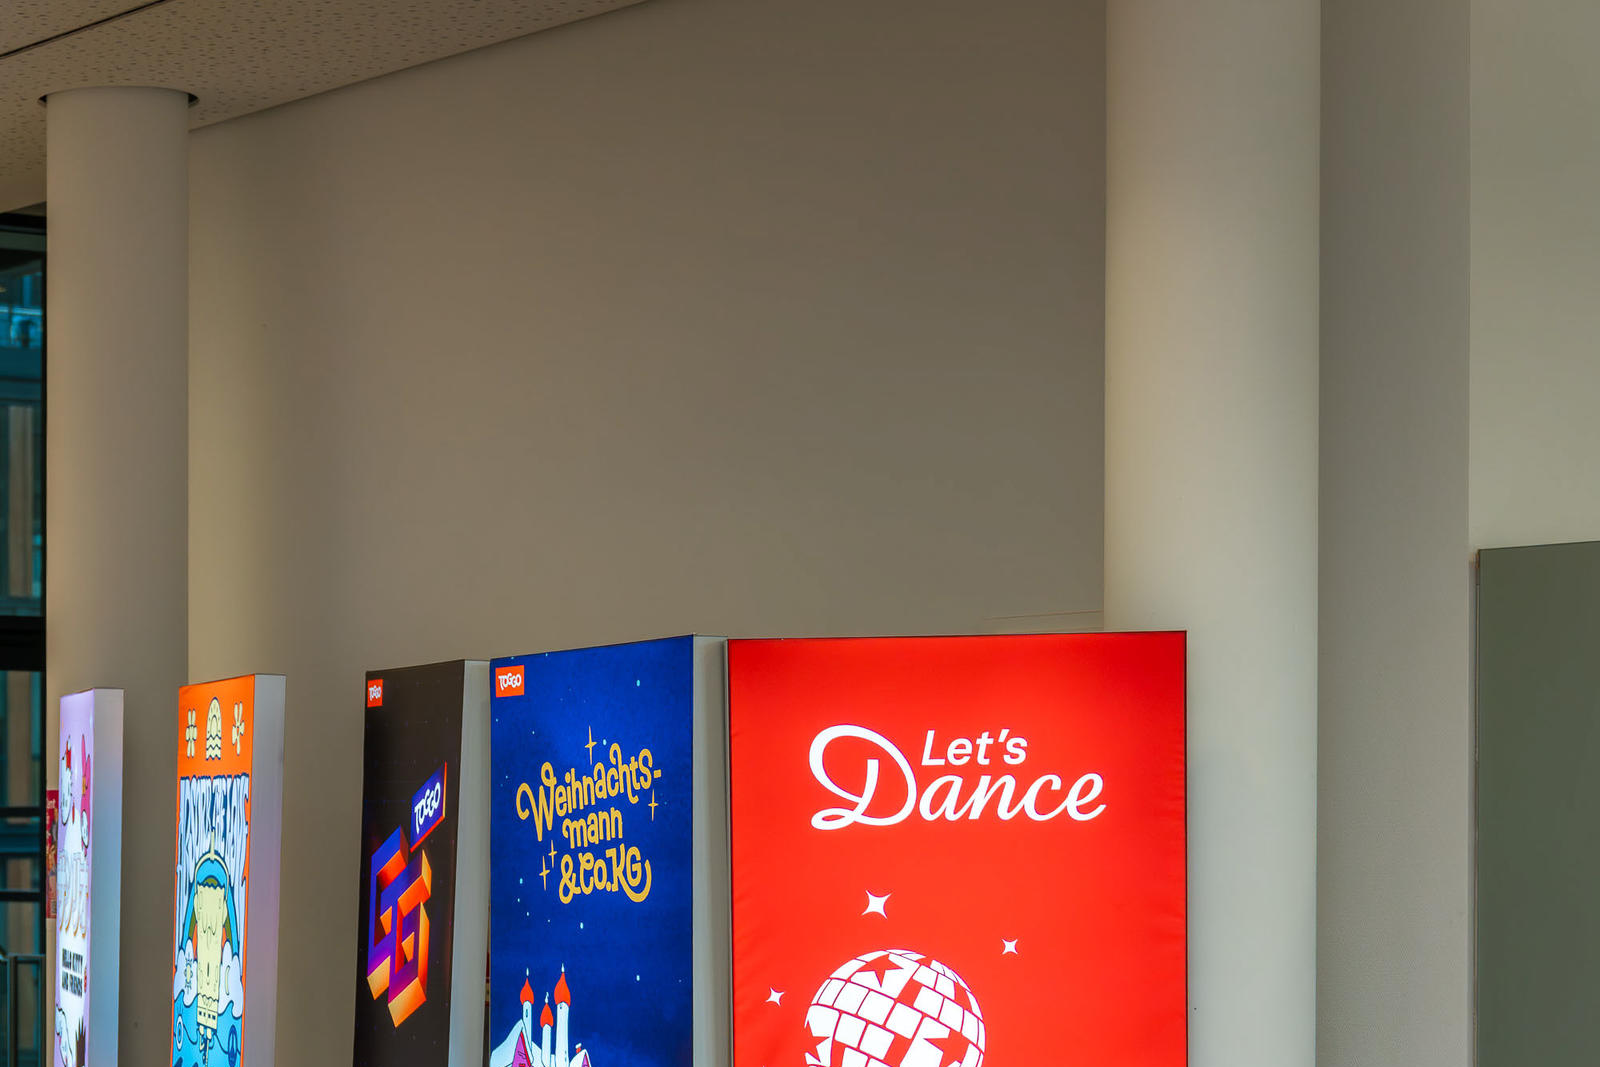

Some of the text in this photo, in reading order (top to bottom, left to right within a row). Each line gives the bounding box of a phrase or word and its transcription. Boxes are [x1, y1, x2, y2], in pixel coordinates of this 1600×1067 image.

[497, 672, 522, 692] TOGGO
[921, 728, 1028, 766] Let's
[515, 742, 662, 842] Weihnachts-
[809, 724, 1107, 831] Dance
[413, 780, 442, 836] TOGGO
[562, 807, 623, 849] mann
